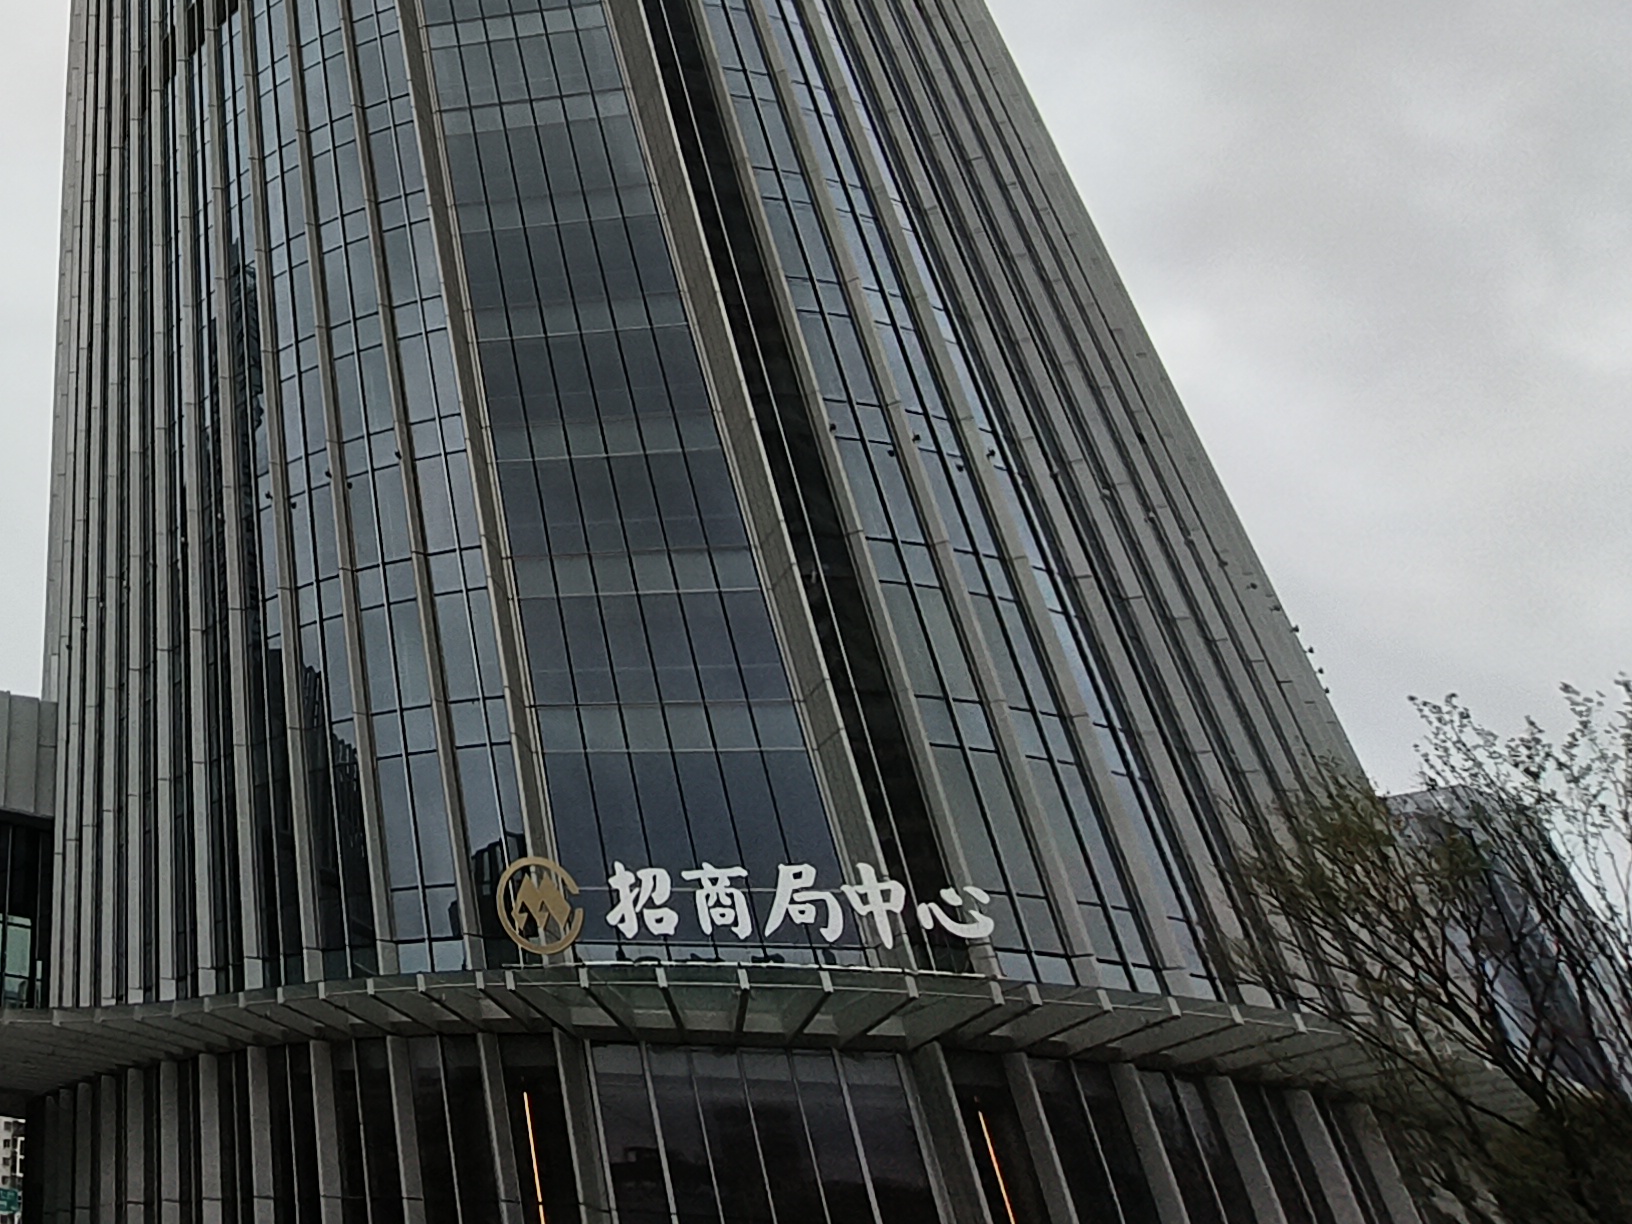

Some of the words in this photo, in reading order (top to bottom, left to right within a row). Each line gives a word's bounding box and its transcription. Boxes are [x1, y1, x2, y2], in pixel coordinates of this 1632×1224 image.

[605, 860, 996, 951] 招商局中心
